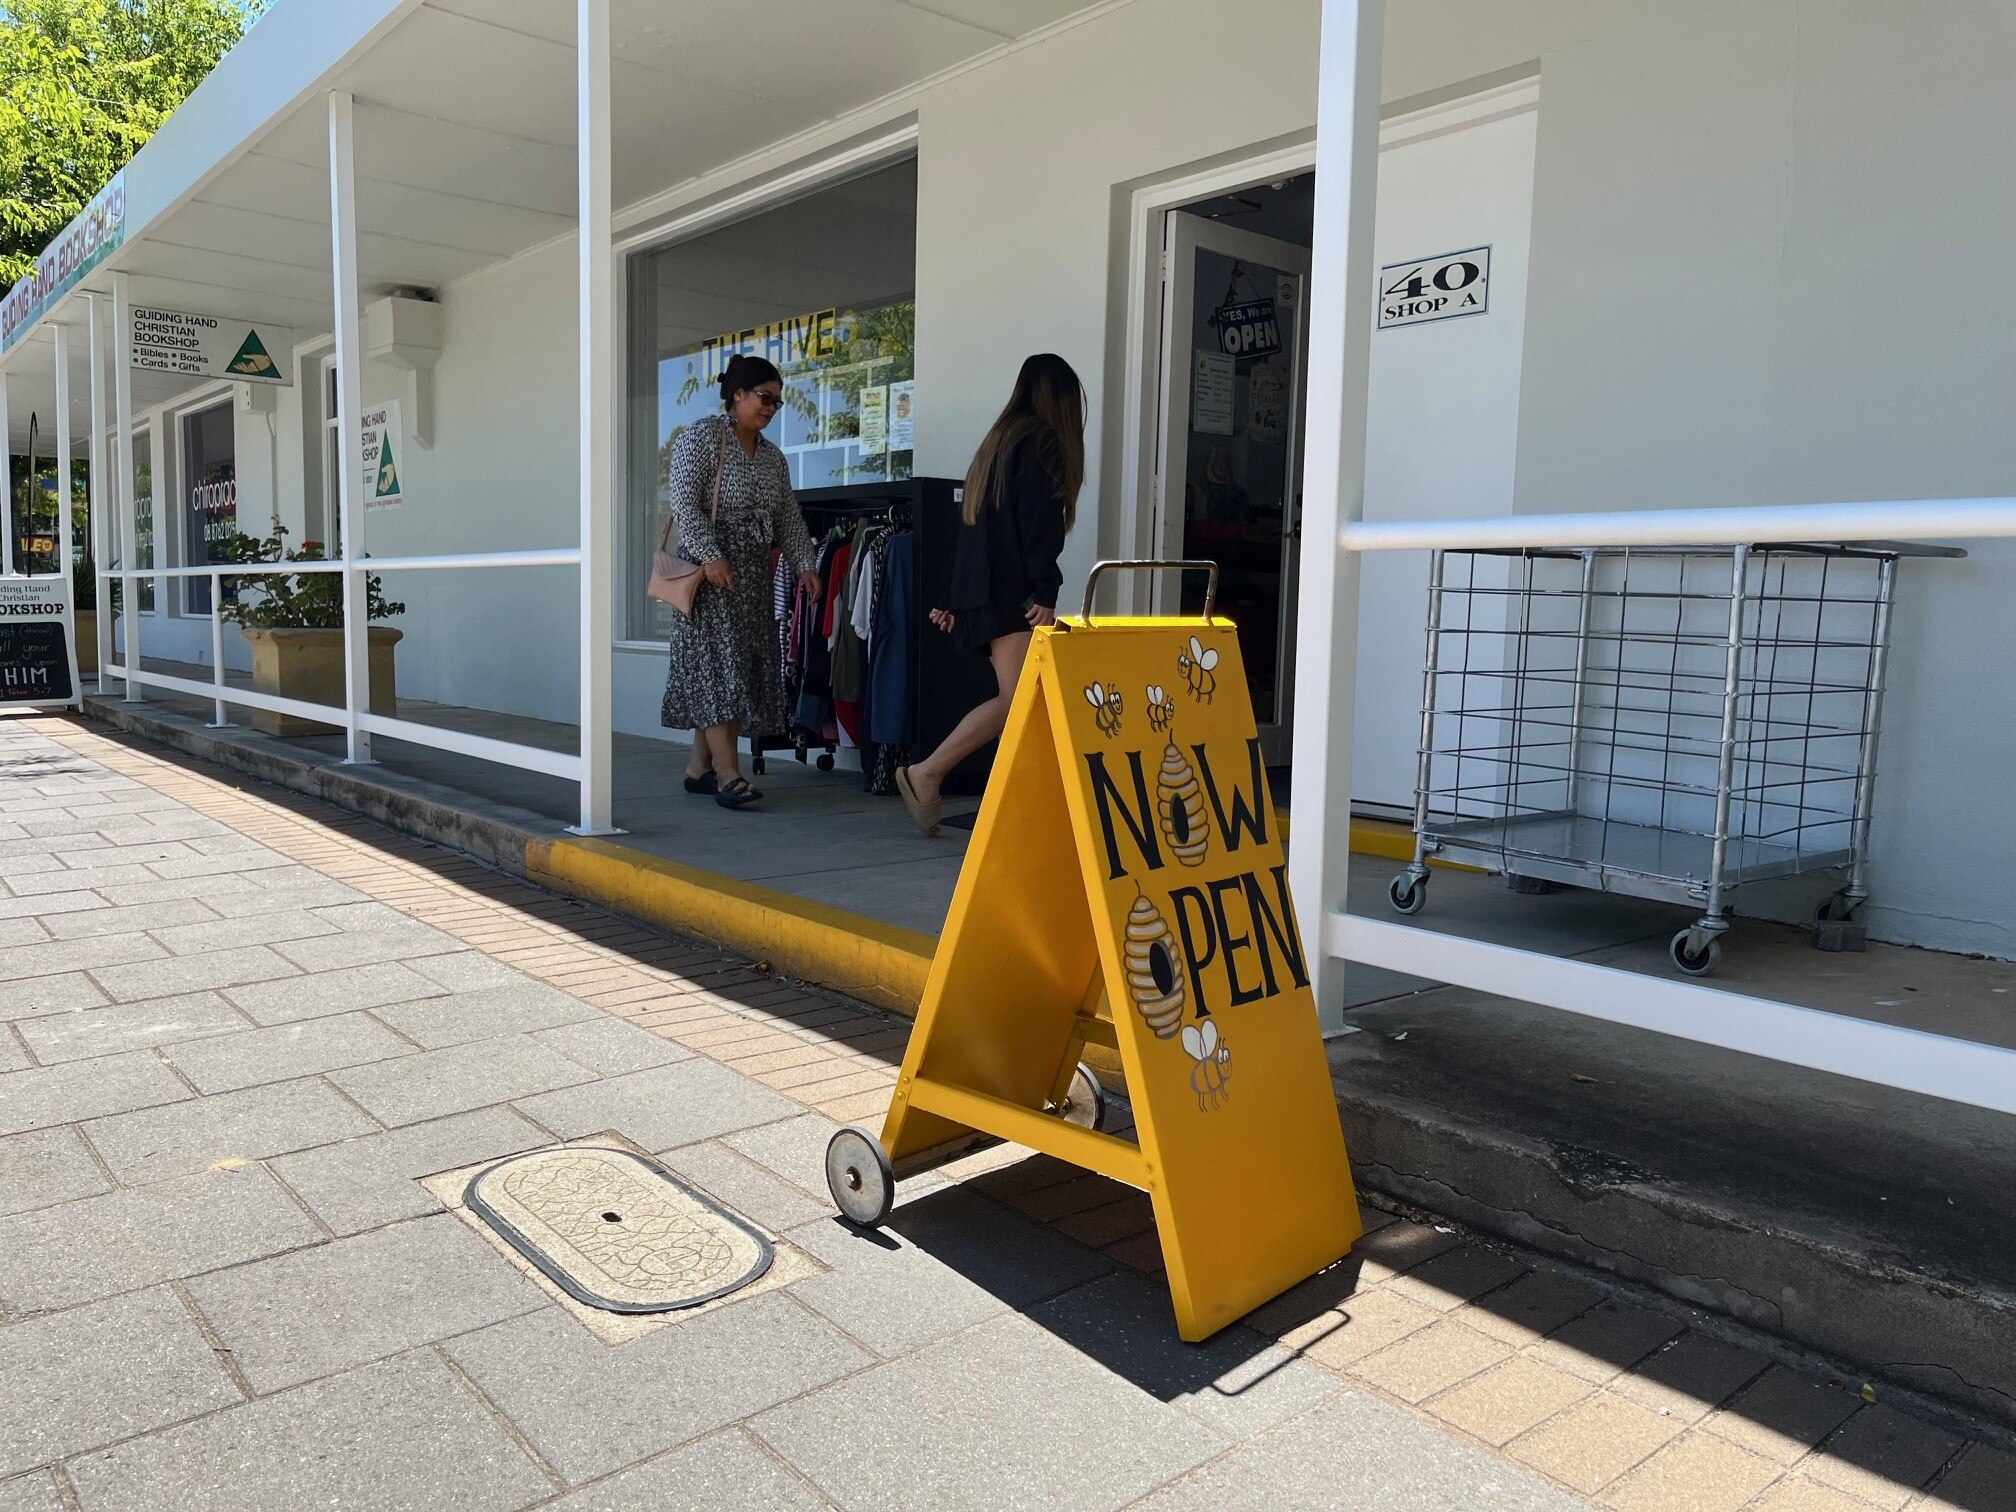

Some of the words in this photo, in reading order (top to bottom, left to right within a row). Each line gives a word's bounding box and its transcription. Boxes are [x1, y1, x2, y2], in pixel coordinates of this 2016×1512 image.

[2, 285, 29, 341] GUIDING
[58, 187, 123, 283] BOOKSHOP
[1384, 261, 1480, 300] 40
[1384, 297, 1449, 320] SHOP
[1459, 292, 1479, 308] A
[134, 309, 182, 324] GUIDING
[185, 316, 218, 328] HAND
[134, 321, 196, 337] CHRISTIAN
[1224, 320, 1278, 354] OPEN
[134, 332, 200, 348] BOOKSHOP
[702, 329, 756, 378] THE
[766, 309, 834, 364] HIVE
[140, 348, 169, 358] Bibles
[180, 353, 209, 363] Books
[141, 358, 169, 368] Cards
[178, 362, 200, 372] Gifts
[371, 410, 387, 425] HAND
[25, 584, 51, 592] Hand
[22, 644, 50, 660] your
[4, 667, 48, 686] HIM
[1083, 730, 1270, 881] NOW
[1123, 865, 1312, 1040] OPEN
